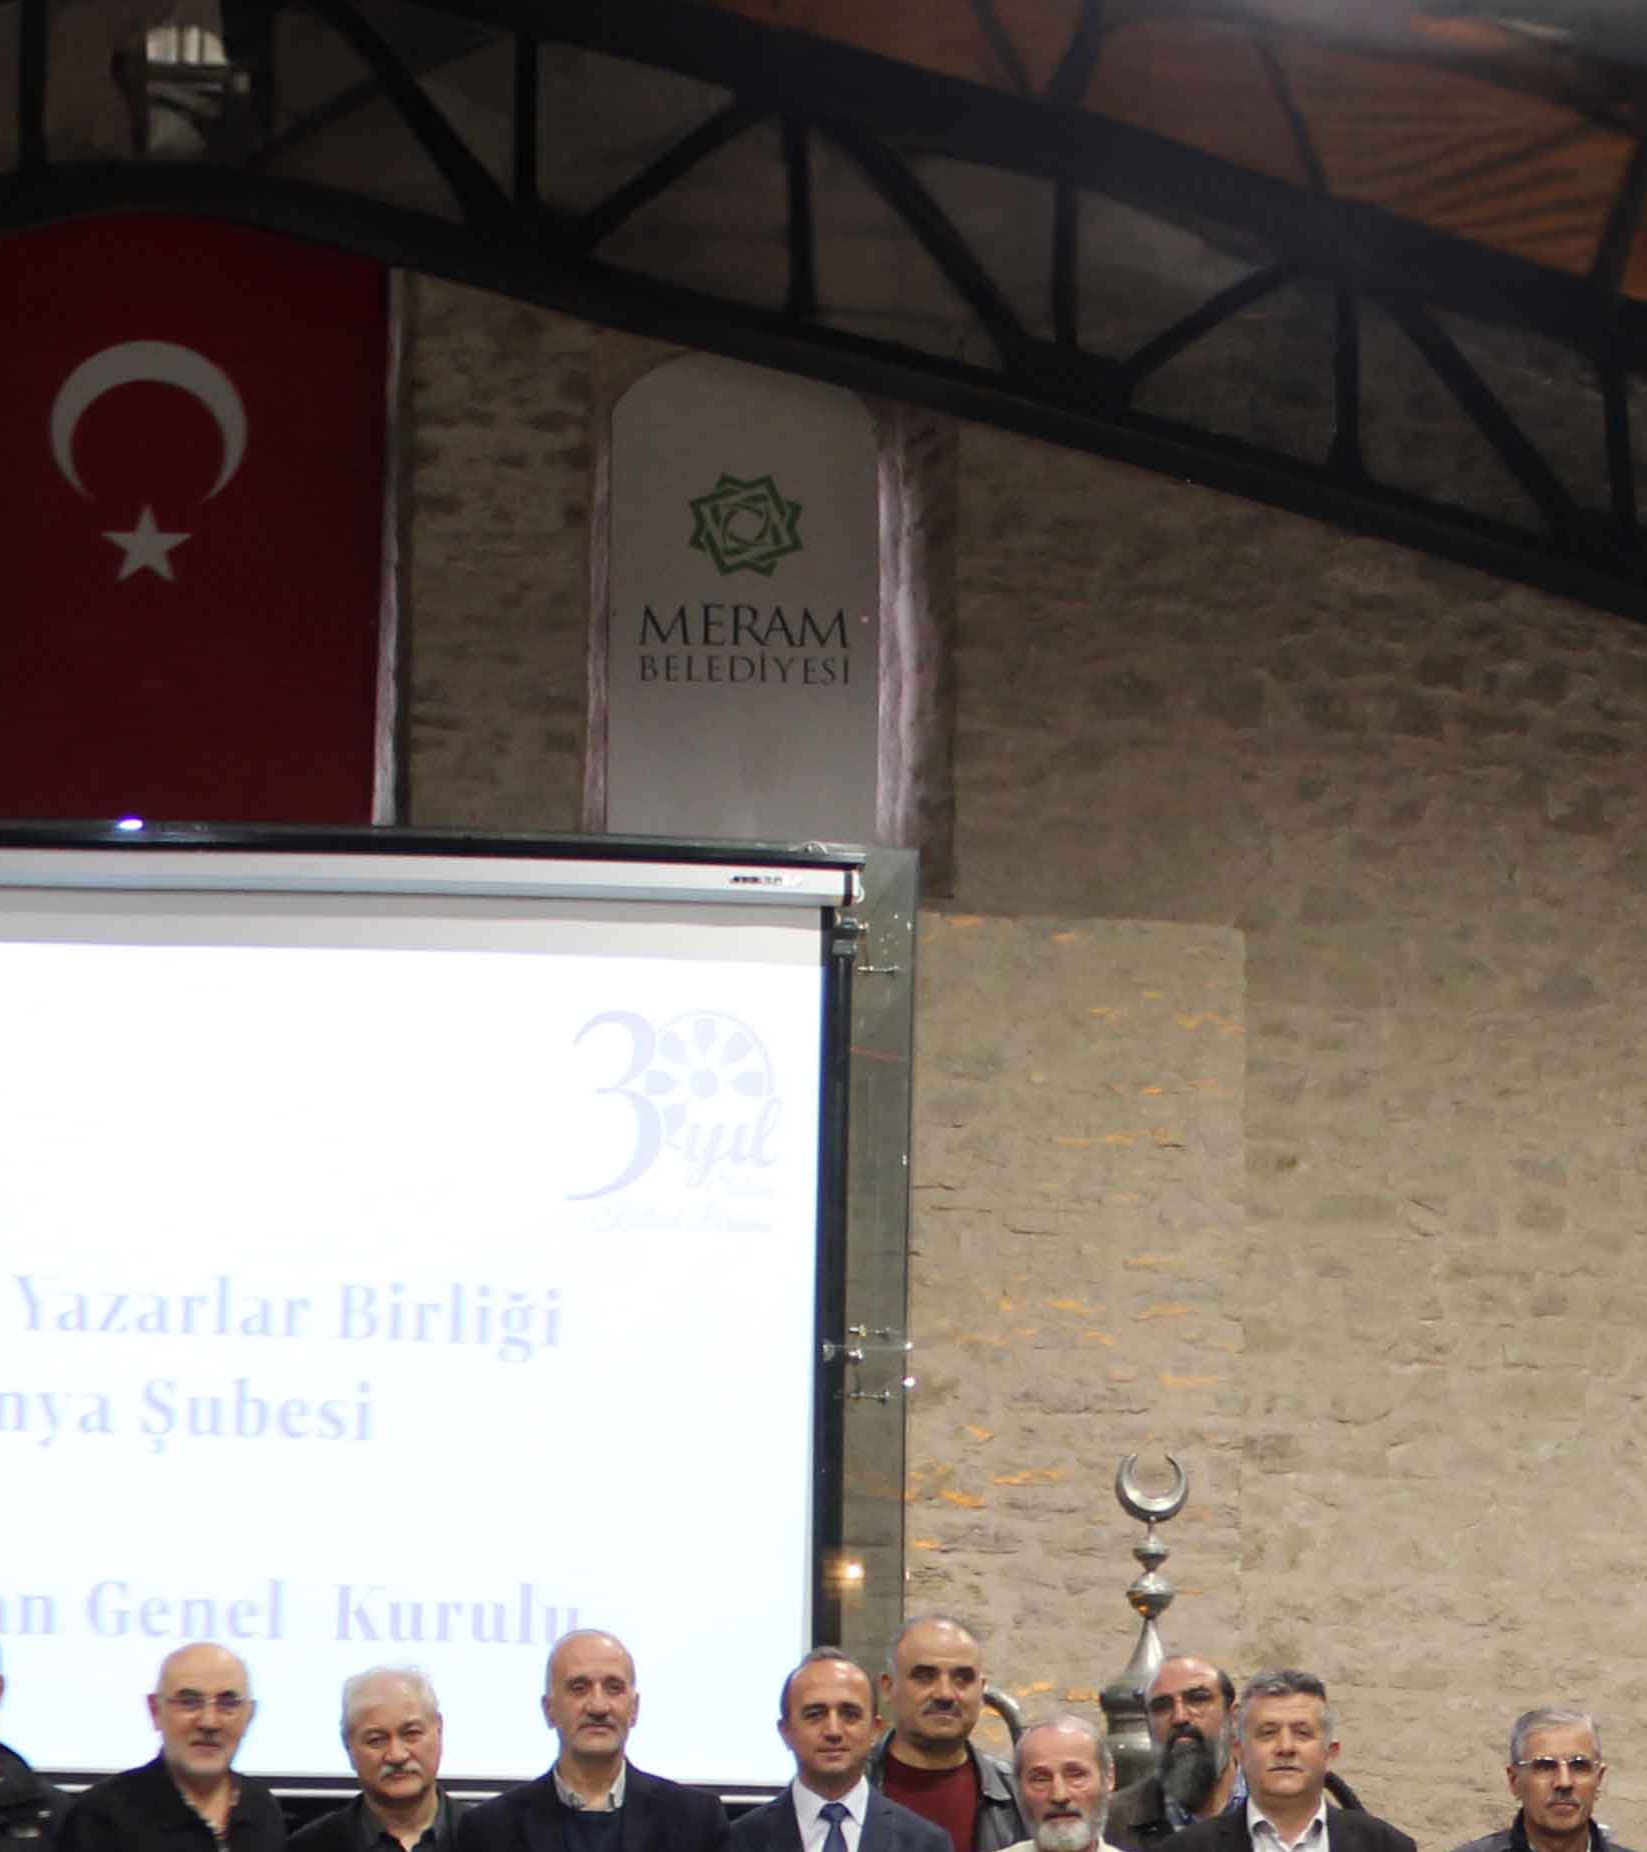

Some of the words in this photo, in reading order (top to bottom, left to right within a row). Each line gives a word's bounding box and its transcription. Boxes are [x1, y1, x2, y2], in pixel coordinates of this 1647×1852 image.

[638, 602, 850, 649] MERAM
[639, 649, 850, 686] BELEDİYESİ
[14, 1274, 313, 1338] Yazarlar
[339, 1281, 561, 1363] Birliği
[140, 1376, 374, 1454] Şubesi
[84, 1578, 288, 1643] Genel
[335, 1582, 583, 1647] Kurulu
